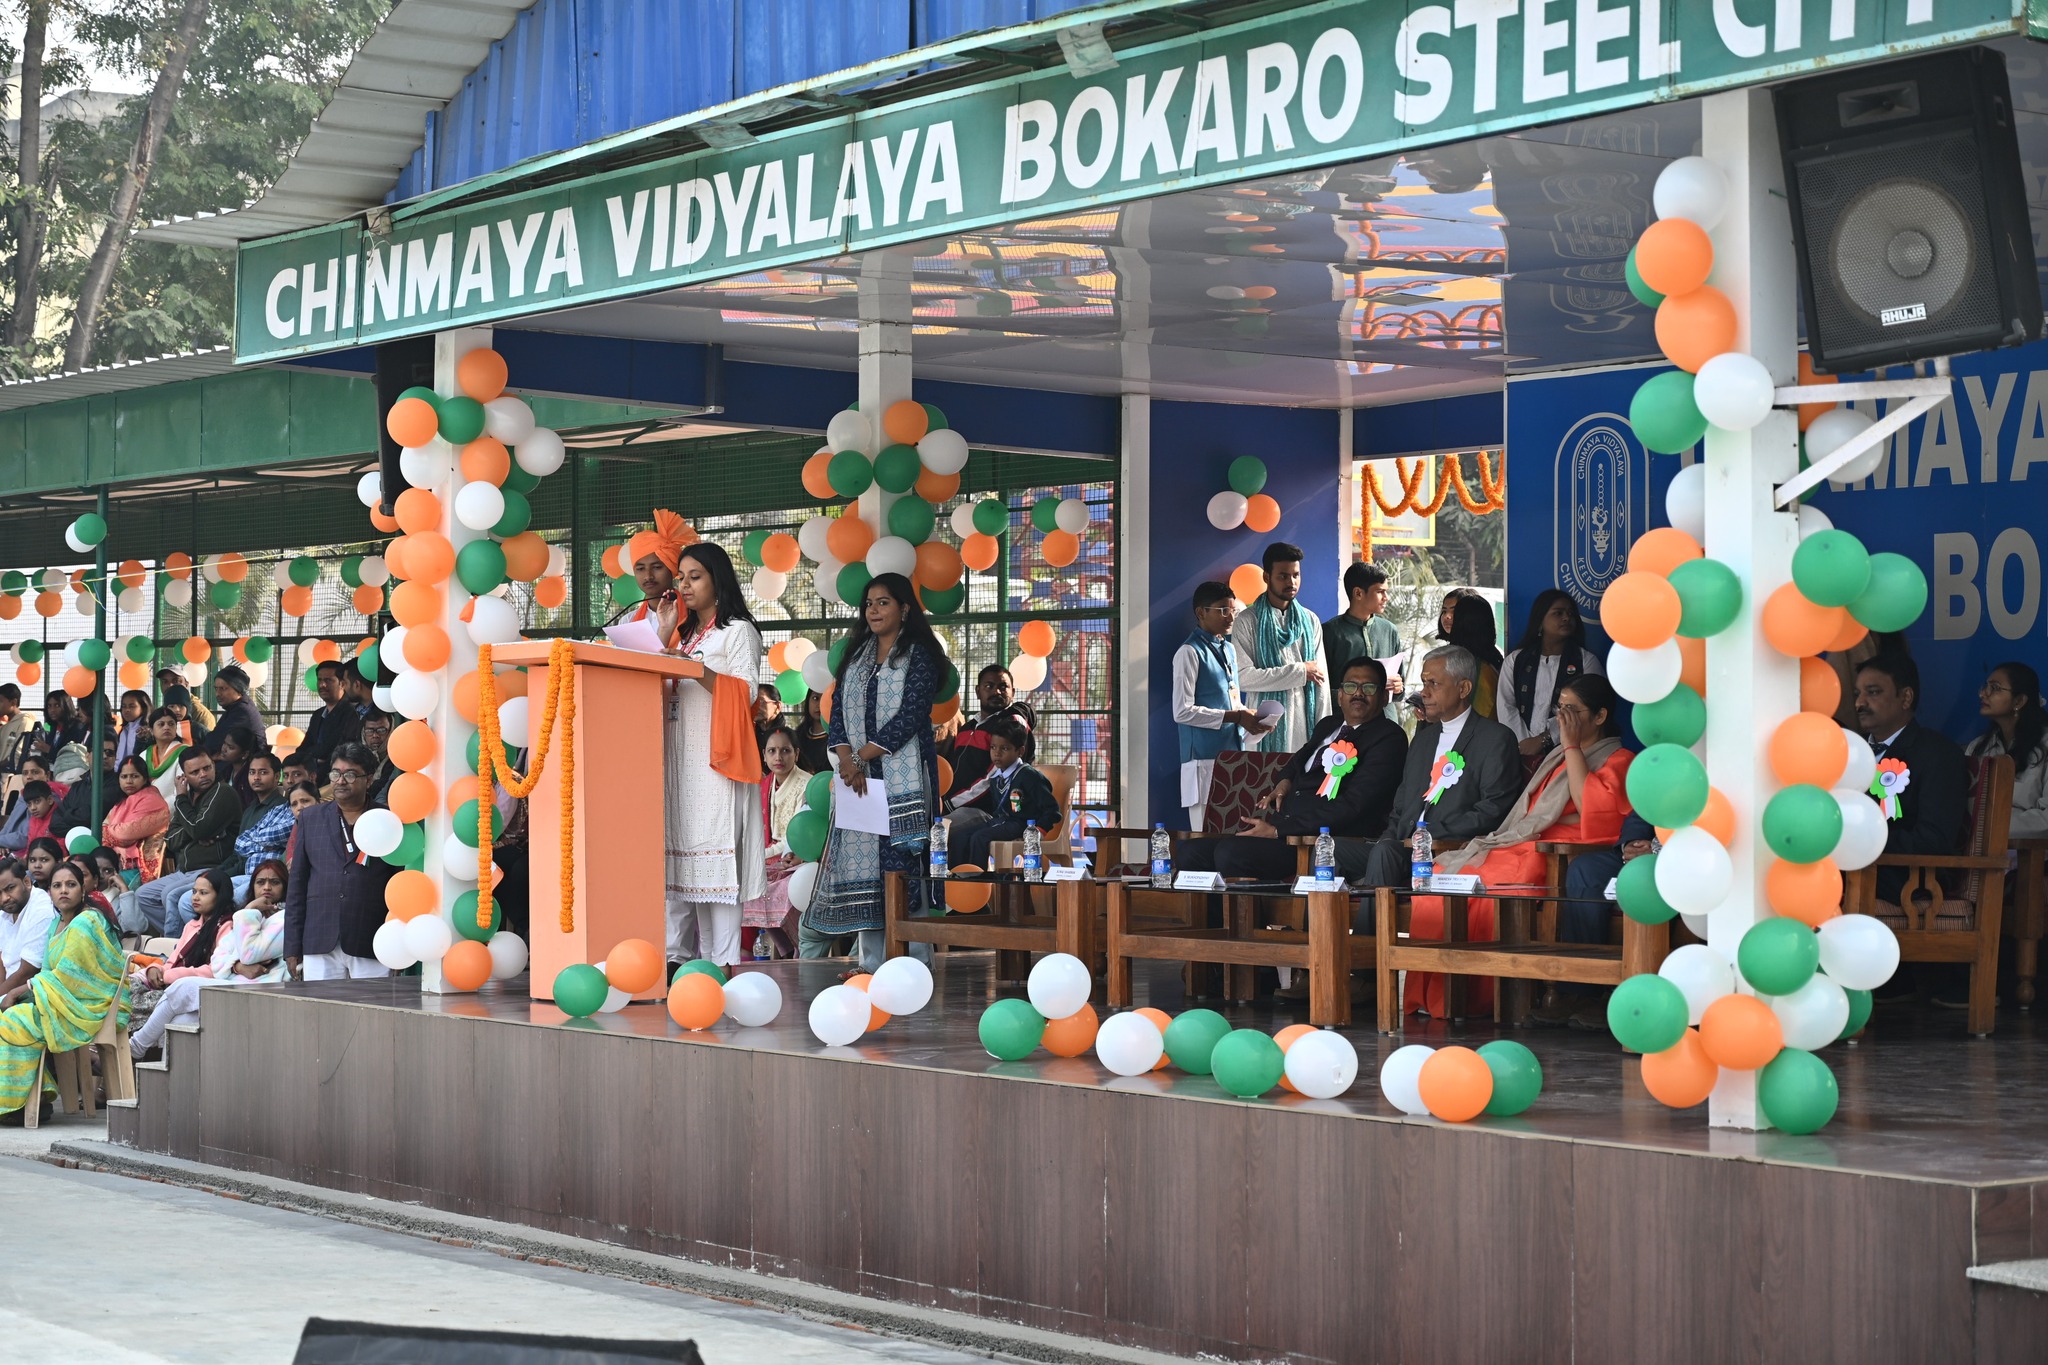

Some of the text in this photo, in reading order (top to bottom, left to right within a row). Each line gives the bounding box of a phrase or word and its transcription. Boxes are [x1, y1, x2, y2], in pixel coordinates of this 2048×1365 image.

[265, 0, 1682, 340] CHINMAYA VIDYALAYA BOKARO STEEL
[1880, 305, 1927, 324] AHUJA
[1577, 434, 1624, 480] CHINMAYA VIDYALAYA
[1560, 562, 1600, 611] CHINMAY
[1577, 557, 1592, 582] KEEP
[1934, 527, 2048, 640] BO
